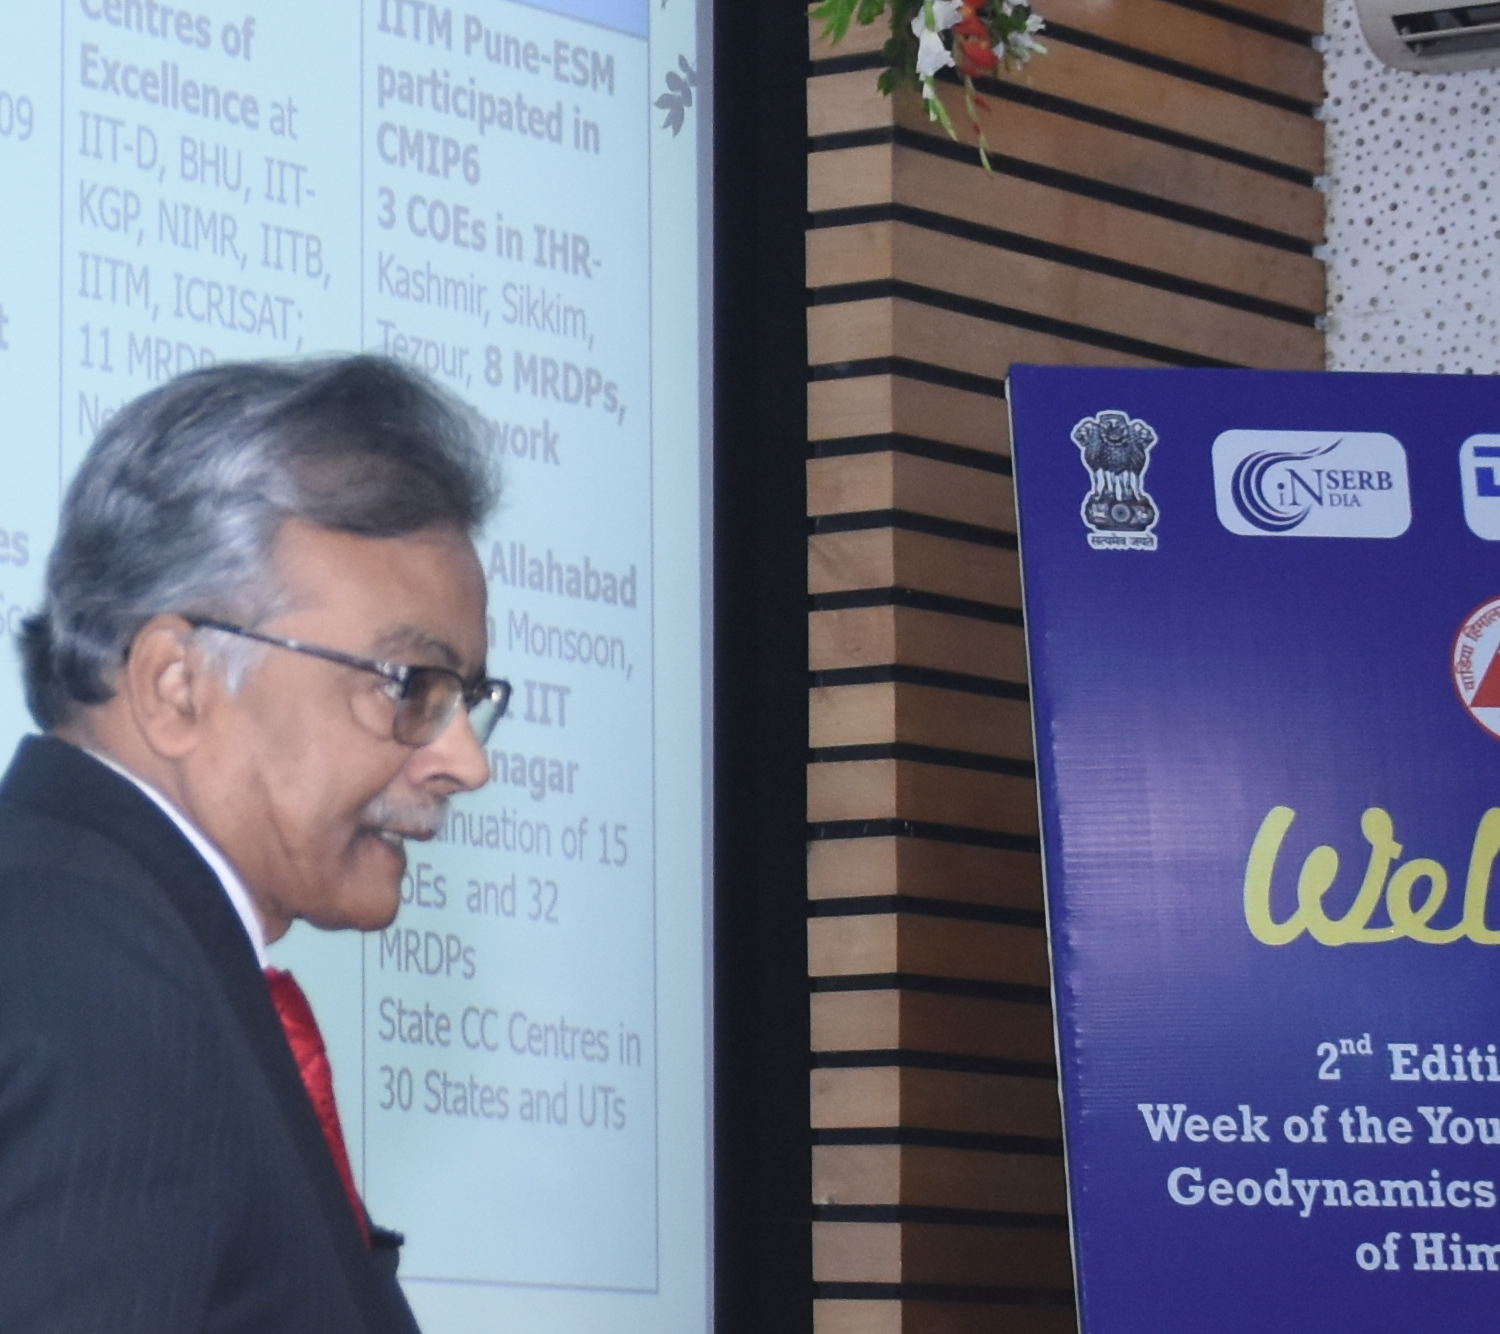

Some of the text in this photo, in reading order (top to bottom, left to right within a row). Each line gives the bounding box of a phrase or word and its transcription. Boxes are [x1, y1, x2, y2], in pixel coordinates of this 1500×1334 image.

[220, 16, 256, 61] of
[464, 14, 617, 98] Pune-ESM
[79, 41, 299, 141] Excellence at
[377, 64, 601, 155] participated in
[376, 121, 481, 186] CMIP6
[495, 212, 524, 262] in
[1325, 470, 1393, 490] SERB
[561, 815, 629, 868] of 15
[465, 875, 560, 924] and 32
[378, 996, 641, 1066] State CC Centres in
[1317, 1034, 1373, 1083] 2nd
[379, 1064, 628, 1132] 30 States and UTs
[1138, 1104, 1270, 1143] Week
[1283, 1105, 1331, 1144] of
[1341, 1106, 1412, 1145] the
[1167, 1167, 1497, 1217] Geodynamics
[1355, 1232, 1402, 1272] of
